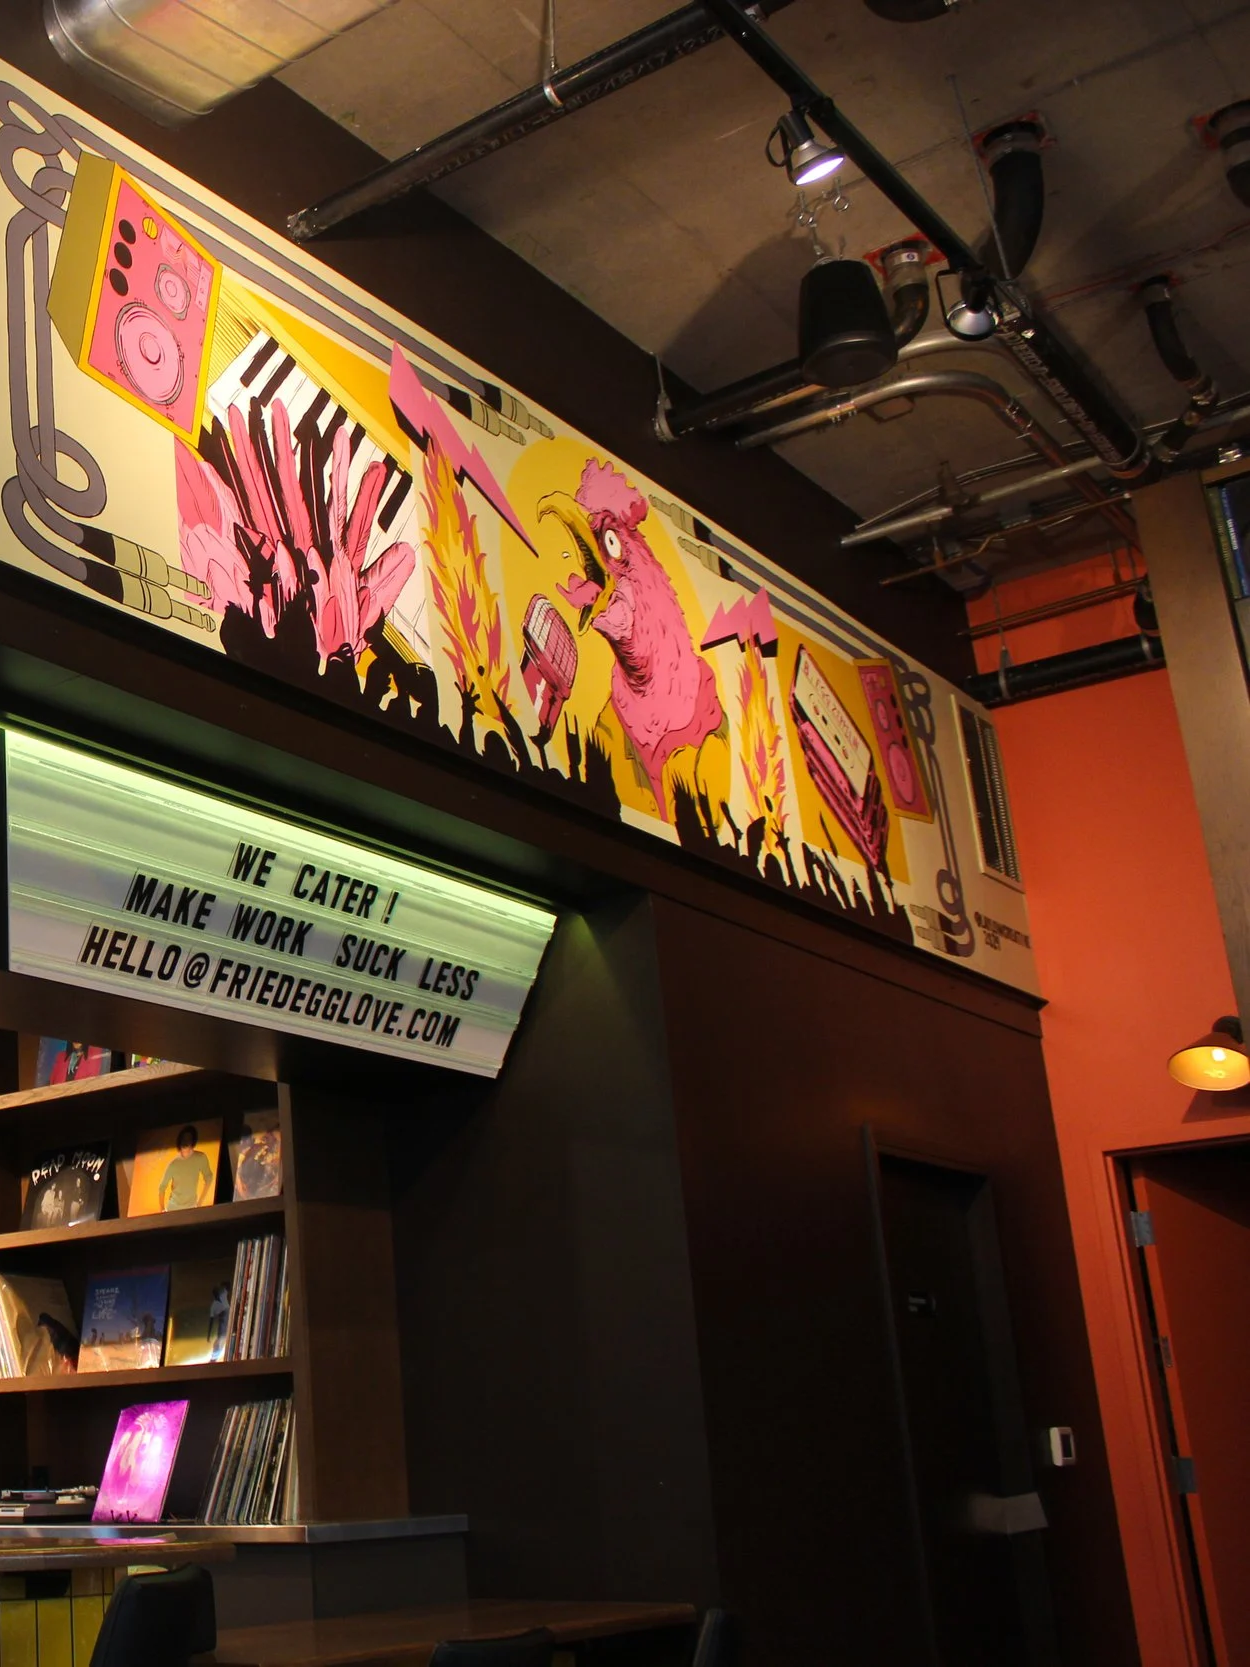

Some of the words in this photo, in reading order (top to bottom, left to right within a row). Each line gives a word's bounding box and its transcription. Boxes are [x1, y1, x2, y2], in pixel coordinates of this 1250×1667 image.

[234, 841, 277, 887] WE
[293, 863, 380, 920] CATER
[123, 873, 216, 931] MAKE
[232, 903, 314, 957] WORK
[336, 933, 406, 982] SUCK
[418, 957, 480, 1001] LESS
